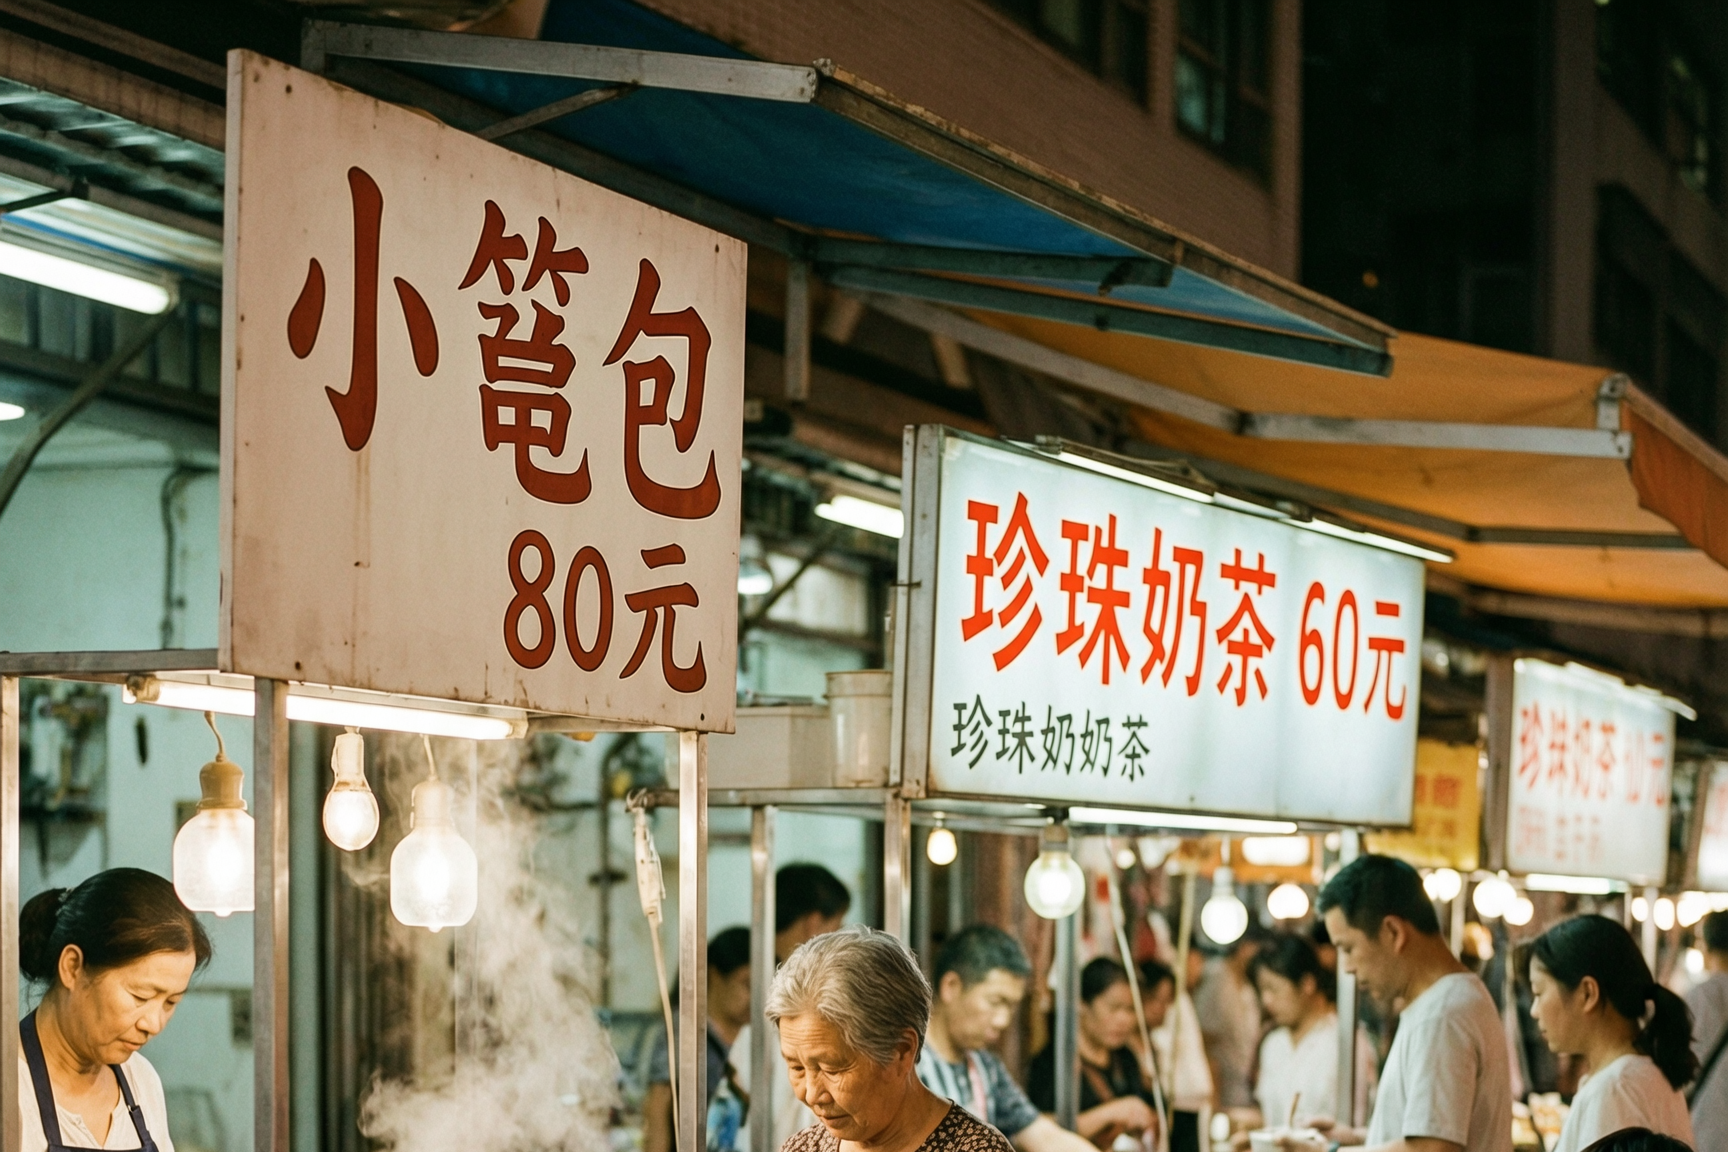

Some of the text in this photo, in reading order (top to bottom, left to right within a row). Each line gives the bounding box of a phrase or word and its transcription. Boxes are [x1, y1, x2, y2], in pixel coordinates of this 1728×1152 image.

[503, 530, 707, 693] 80元
[961, 492, 1406, 720] 珍珠奶茶 60元
[950, 694, 1150, 782] 珍珠奶奶茶
